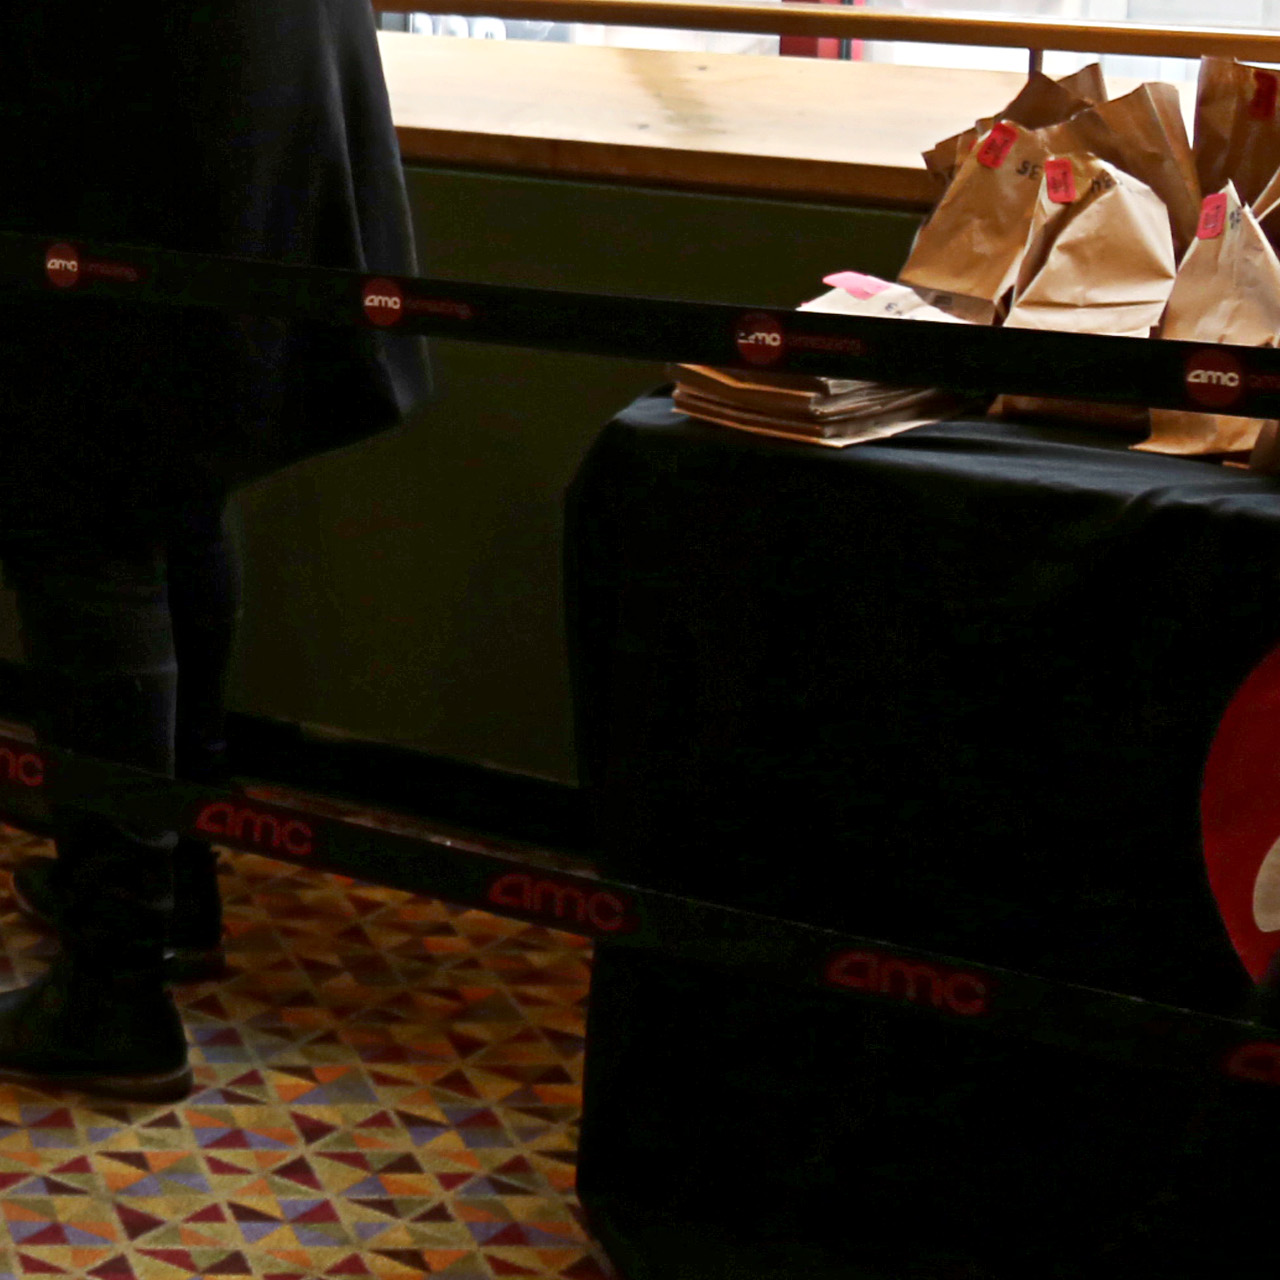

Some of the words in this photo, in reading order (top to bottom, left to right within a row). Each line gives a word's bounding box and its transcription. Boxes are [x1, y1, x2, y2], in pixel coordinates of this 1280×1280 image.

[46, 258, 78, 273] amc
[363, 294, 402, 310] amc
[1186, 369, 1240, 388] amc
[197, 802, 313, 856] amc
[490, 873, 625, 931] amc
[826, 951, 987, 1016] amc
